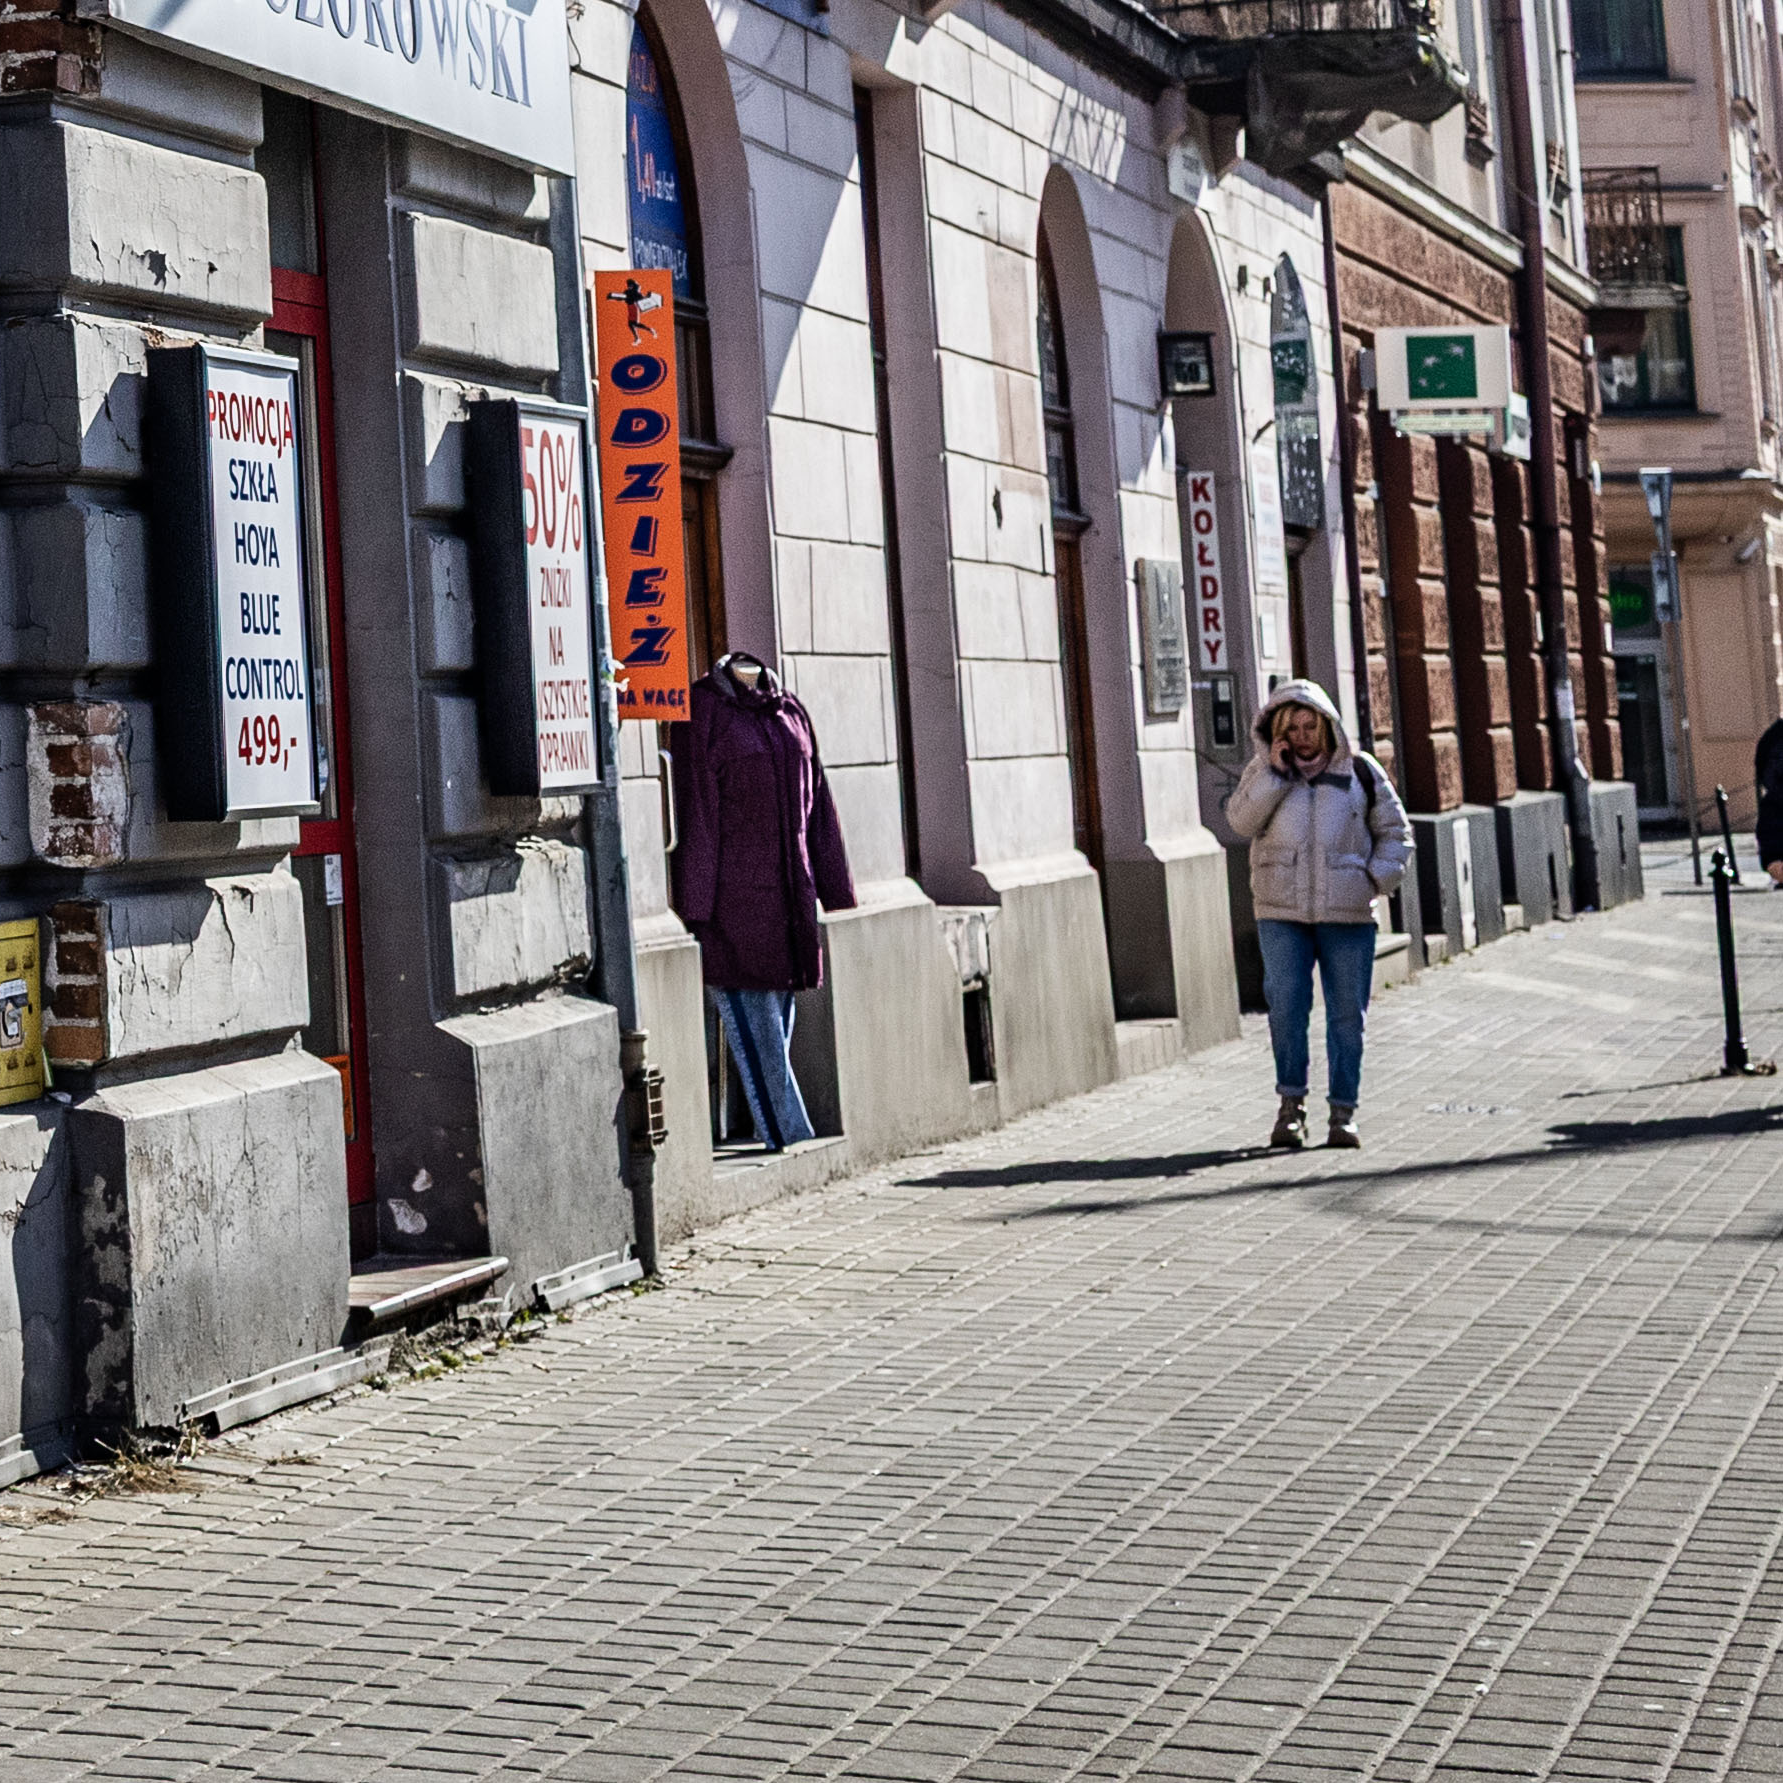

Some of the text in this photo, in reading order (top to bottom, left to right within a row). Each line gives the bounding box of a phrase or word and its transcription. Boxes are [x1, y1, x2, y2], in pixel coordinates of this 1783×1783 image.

[207, 389, 294, 459] PROMOCJA
[229, 458, 279, 504] SZKŁA
[520, 426, 581, 554] 50%
[610, 354, 675, 668] ODZIEŻ
[234, 522, 280, 569] HOYA
[540, 559, 573, 608] ZNIŻKI
[1191, 476, 1224, 666] KOŁDRY
[240, 592, 282, 636] BLUE
[549, 625, 565, 667] NA
[225, 658, 304, 701] CONTROL
[643, 688, 686, 714] WAGĘ
[237, 714, 298, 771] 499,-
[539, 730, 590, 773] OPRAWKI
